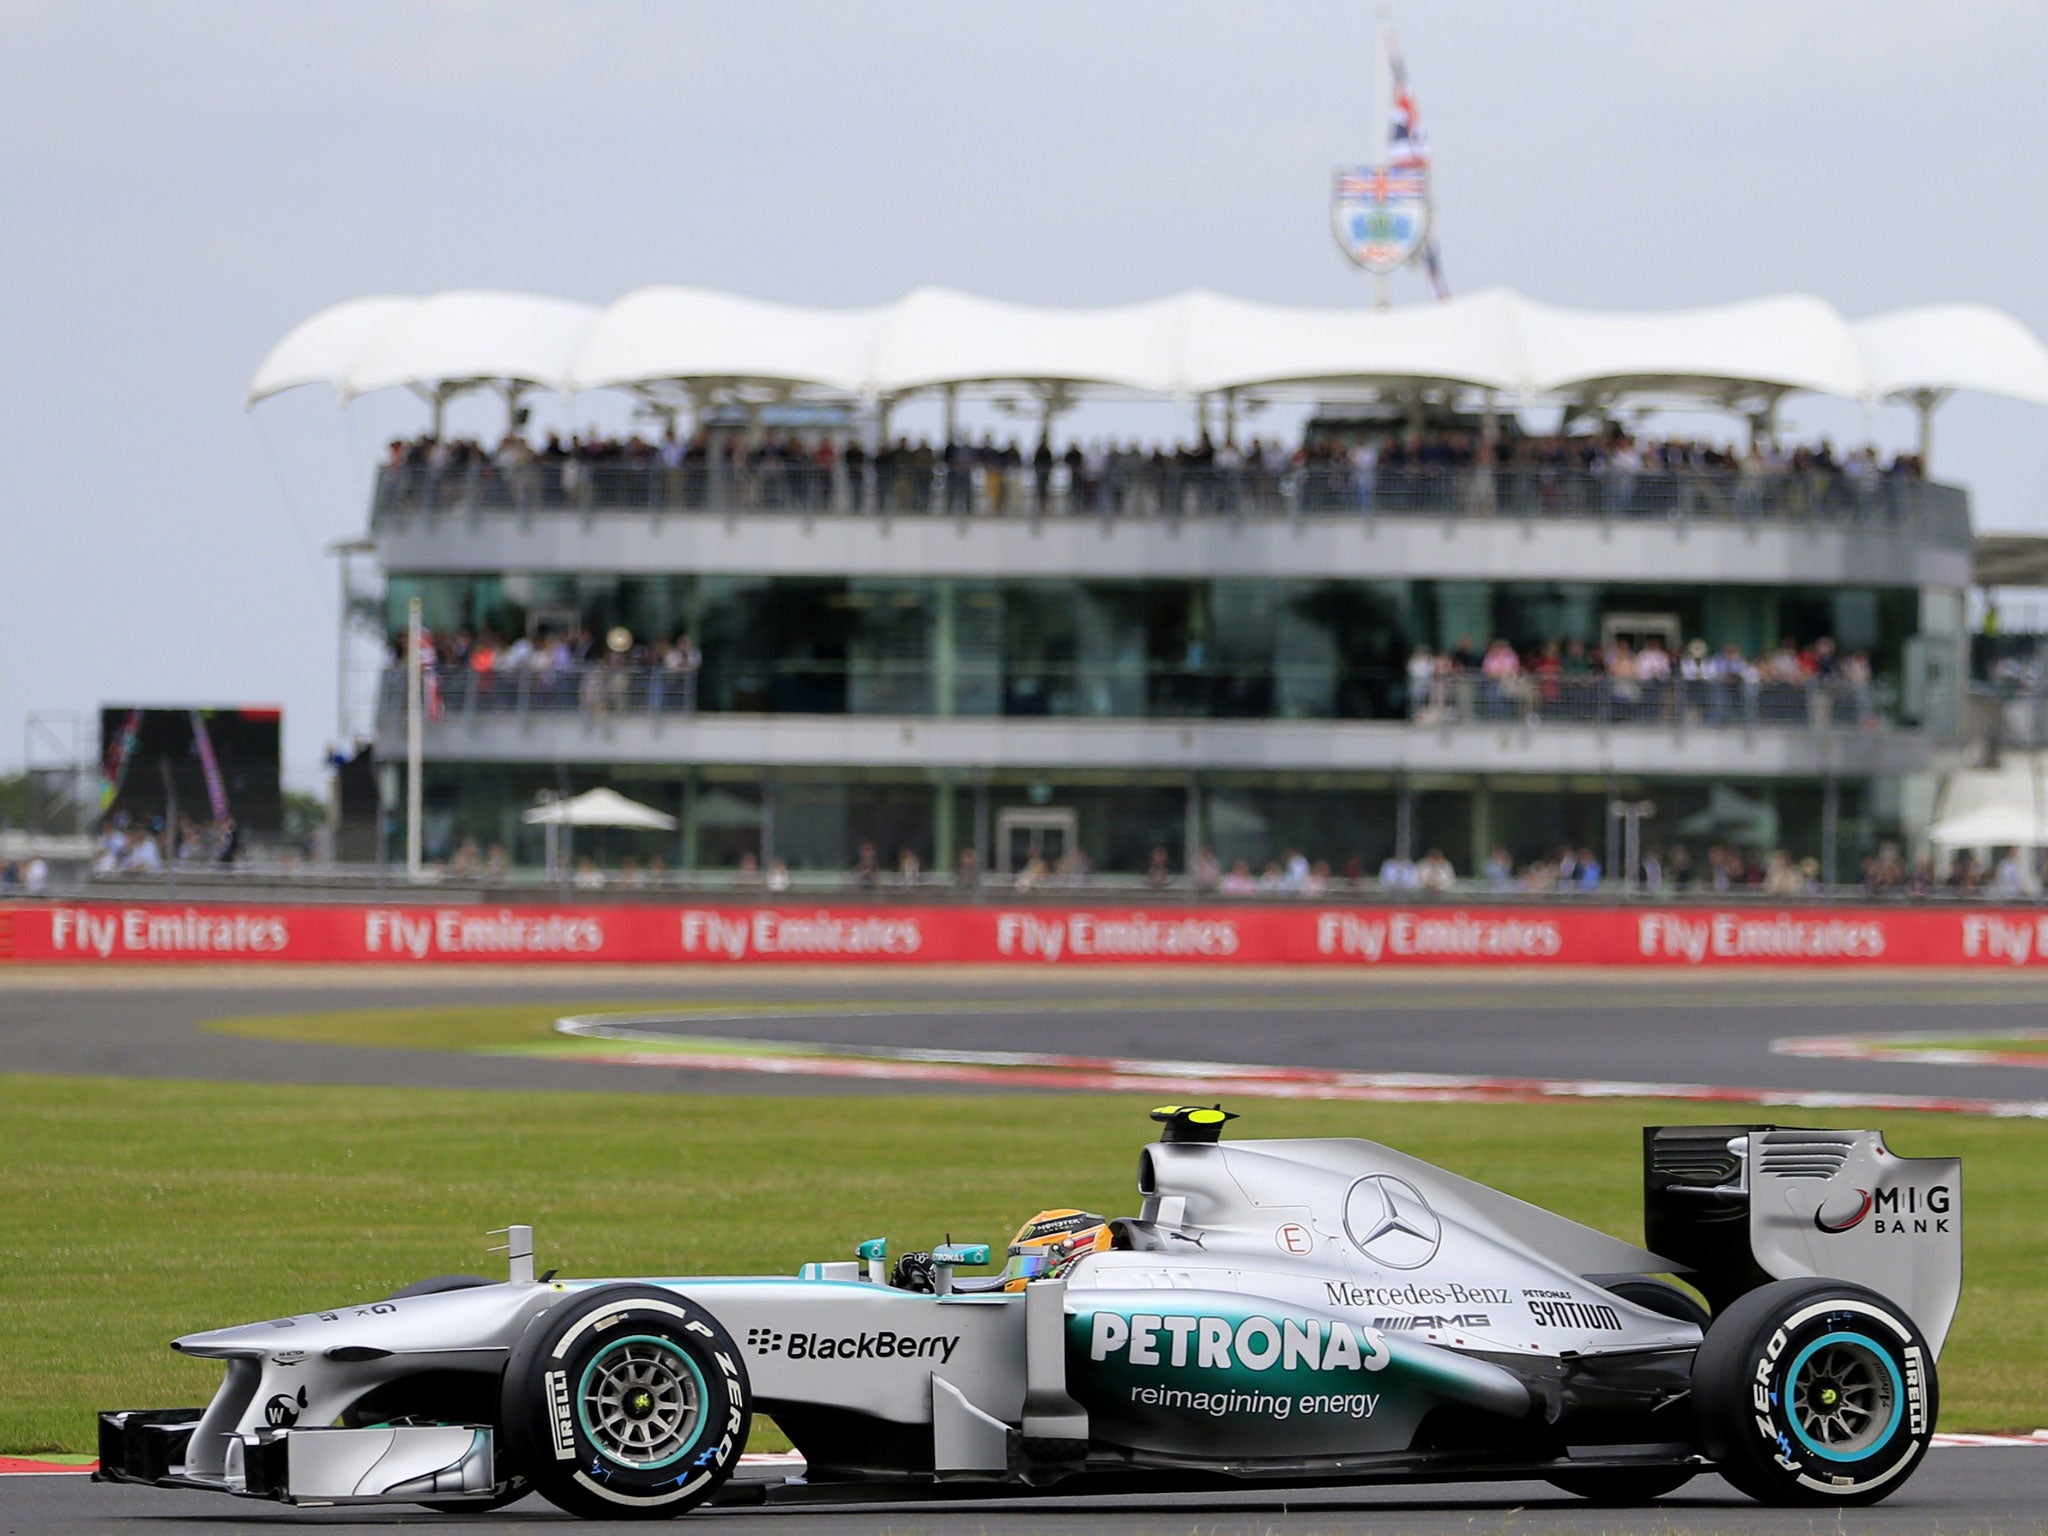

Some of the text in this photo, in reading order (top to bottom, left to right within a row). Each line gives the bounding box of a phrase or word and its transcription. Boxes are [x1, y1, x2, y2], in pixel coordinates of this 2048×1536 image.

[52, 908, 287, 957] Fly Emirates
[365, 909, 604, 959] Fly Emirates
[682, 909, 921, 959] Fly Emirates
[997, 911, 1239, 962] Fly Emirates
[1317, 910, 1561, 962] Fly Emirates
[1638, 911, 1886, 963] Fly Emirates
[1961, 914, 2033, 966] Fly
[1037, 1219, 1080, 1230] MONSTER
[1284, 1227, 1306, 1253] E
[1875, 1219, 1949, 1234] BANK
[1323, 1282, 1513, 1307] Mercedes-Benz
[1522, 1289, 1572, 1300] PETRONAS
[1528, 1300, 1623, 1331] SYNTIUM
[1090, 1311, 1392, 1372] PETRONAS
[1408, 1314, 1491, 1330] AMG
[787, 1331, 960, 1364] BlackBerry
[685, 1320, 744, 1468] P ZERO
[1132, 1385, 1381, 1419] reimagining energy
[1753, 1328, 1788, 1440] ZERO
[1903, 1346, 1928, 1435] PIRELLI
[544, 1370, 577, 1461] PIRELLI
